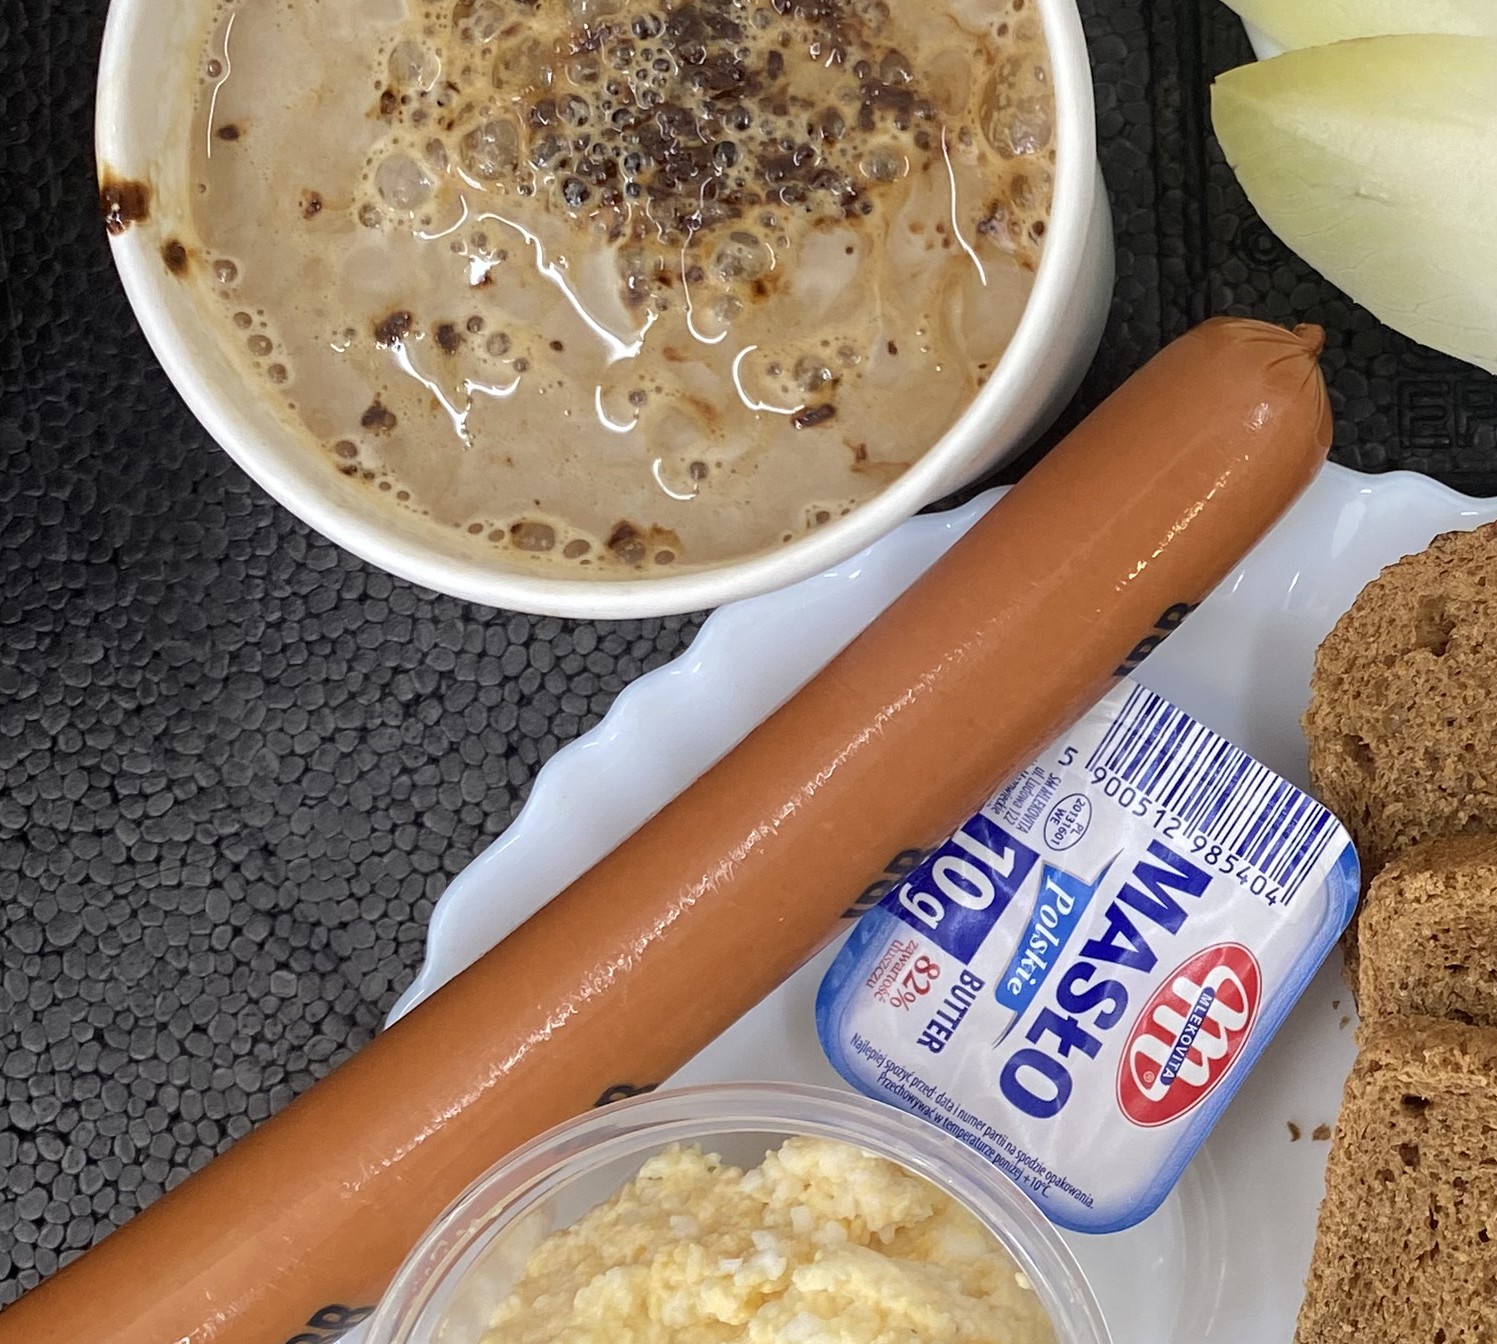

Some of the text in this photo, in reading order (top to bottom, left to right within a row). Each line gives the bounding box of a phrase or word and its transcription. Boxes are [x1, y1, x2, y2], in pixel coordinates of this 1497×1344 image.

[991, 770, 1029, 815] Mowieckie
[1012, 777, 1041, 809] Ludowa
[1031, 766, 1045, 779] ul.
[1003, 807, 1020, 825] 122
[1015, 772, 1061, 834] SM MLEKOVITA
[1051, 798, 1085, 845] 20131601
[1053, 808, 1067, 825] WE
[1058, 746, 1279, 906] 5 900512 985404
[1070, 822, 1084, 835] PL
[1007, 875, 1075, 995] Polskie
[865, 939, 904, 989] tłuszczu
[874, 940, 919, 1001] zawartość
[890, 955, 940, 1011] 82%
[999, 839, 1213, 1119] MASŁO
[916, 969, 985, 1054] BUTTER
[1163, 989, 1213, 1078] MLEKOVITA
